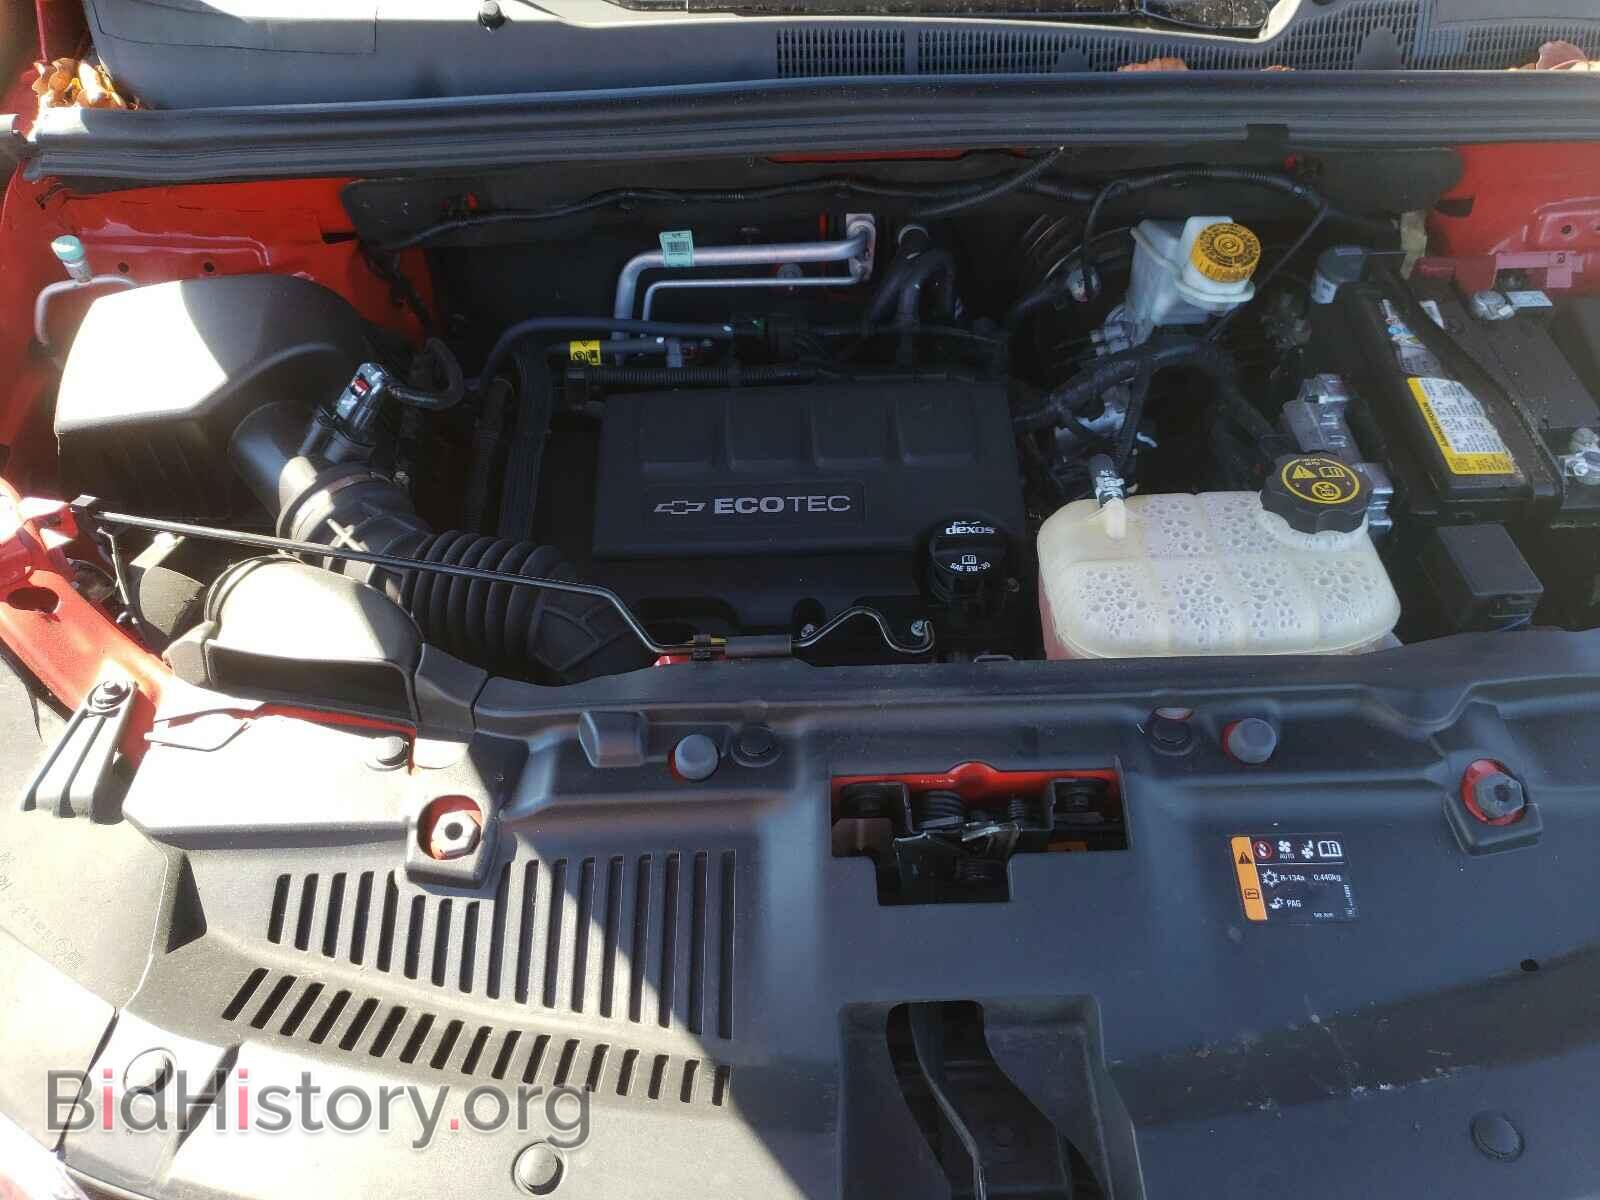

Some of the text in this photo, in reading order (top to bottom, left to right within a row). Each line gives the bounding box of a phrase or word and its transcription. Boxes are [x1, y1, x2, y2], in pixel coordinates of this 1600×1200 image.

[713, 495, 851, 515] ECOTEC
[945, 523, 995, 535] dexos
[950, 561, 991, 572] SAE 5W-30
[1286, 899, 1302, 908] PAG
